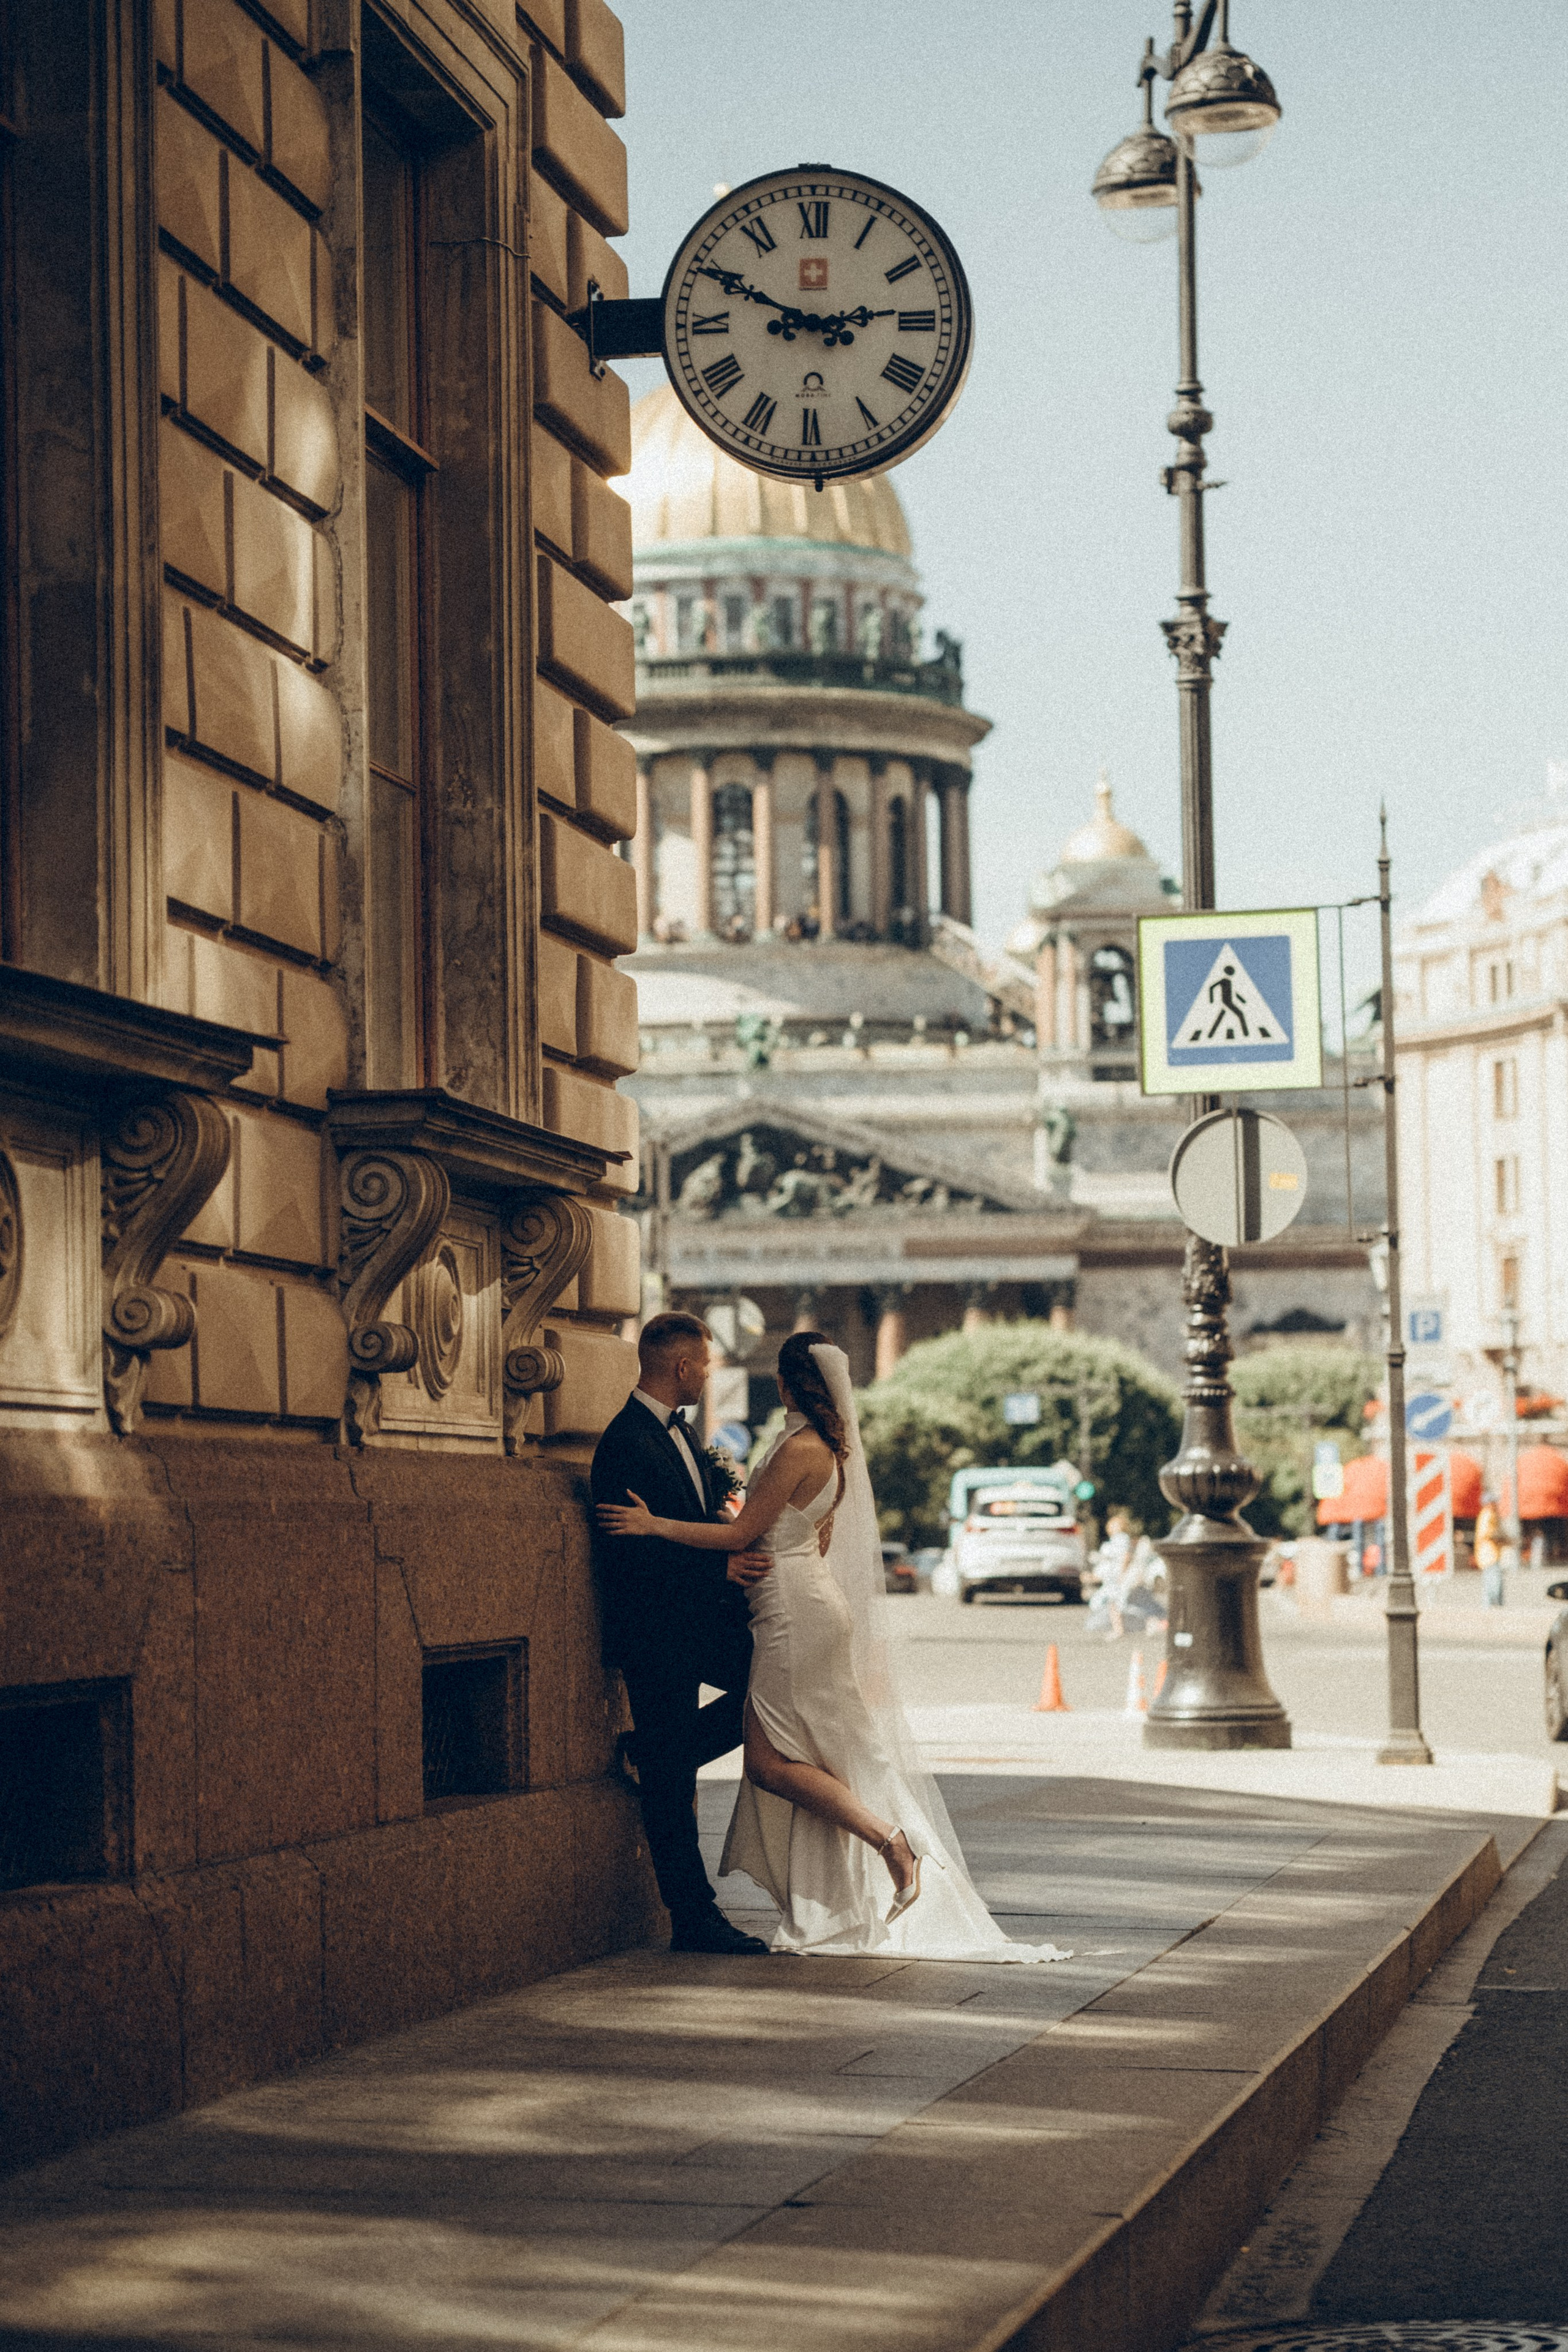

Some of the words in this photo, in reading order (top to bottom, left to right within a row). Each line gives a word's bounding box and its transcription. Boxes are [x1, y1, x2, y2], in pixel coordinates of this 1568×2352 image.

[739, 216, 777, 258] XI
[797, 201, 831, 239] XII
[884, 254, 922, 284] II
[692, 311, 729, 336] IX
[898, 309, 936, 331] III
[701, 353, 745, 400] VIII
[880, 353, 925, 394] IIII
[742, 392, 777, 435] VII
[802, 408, 822, 446] VI
[855, 396, 880, 431] V
